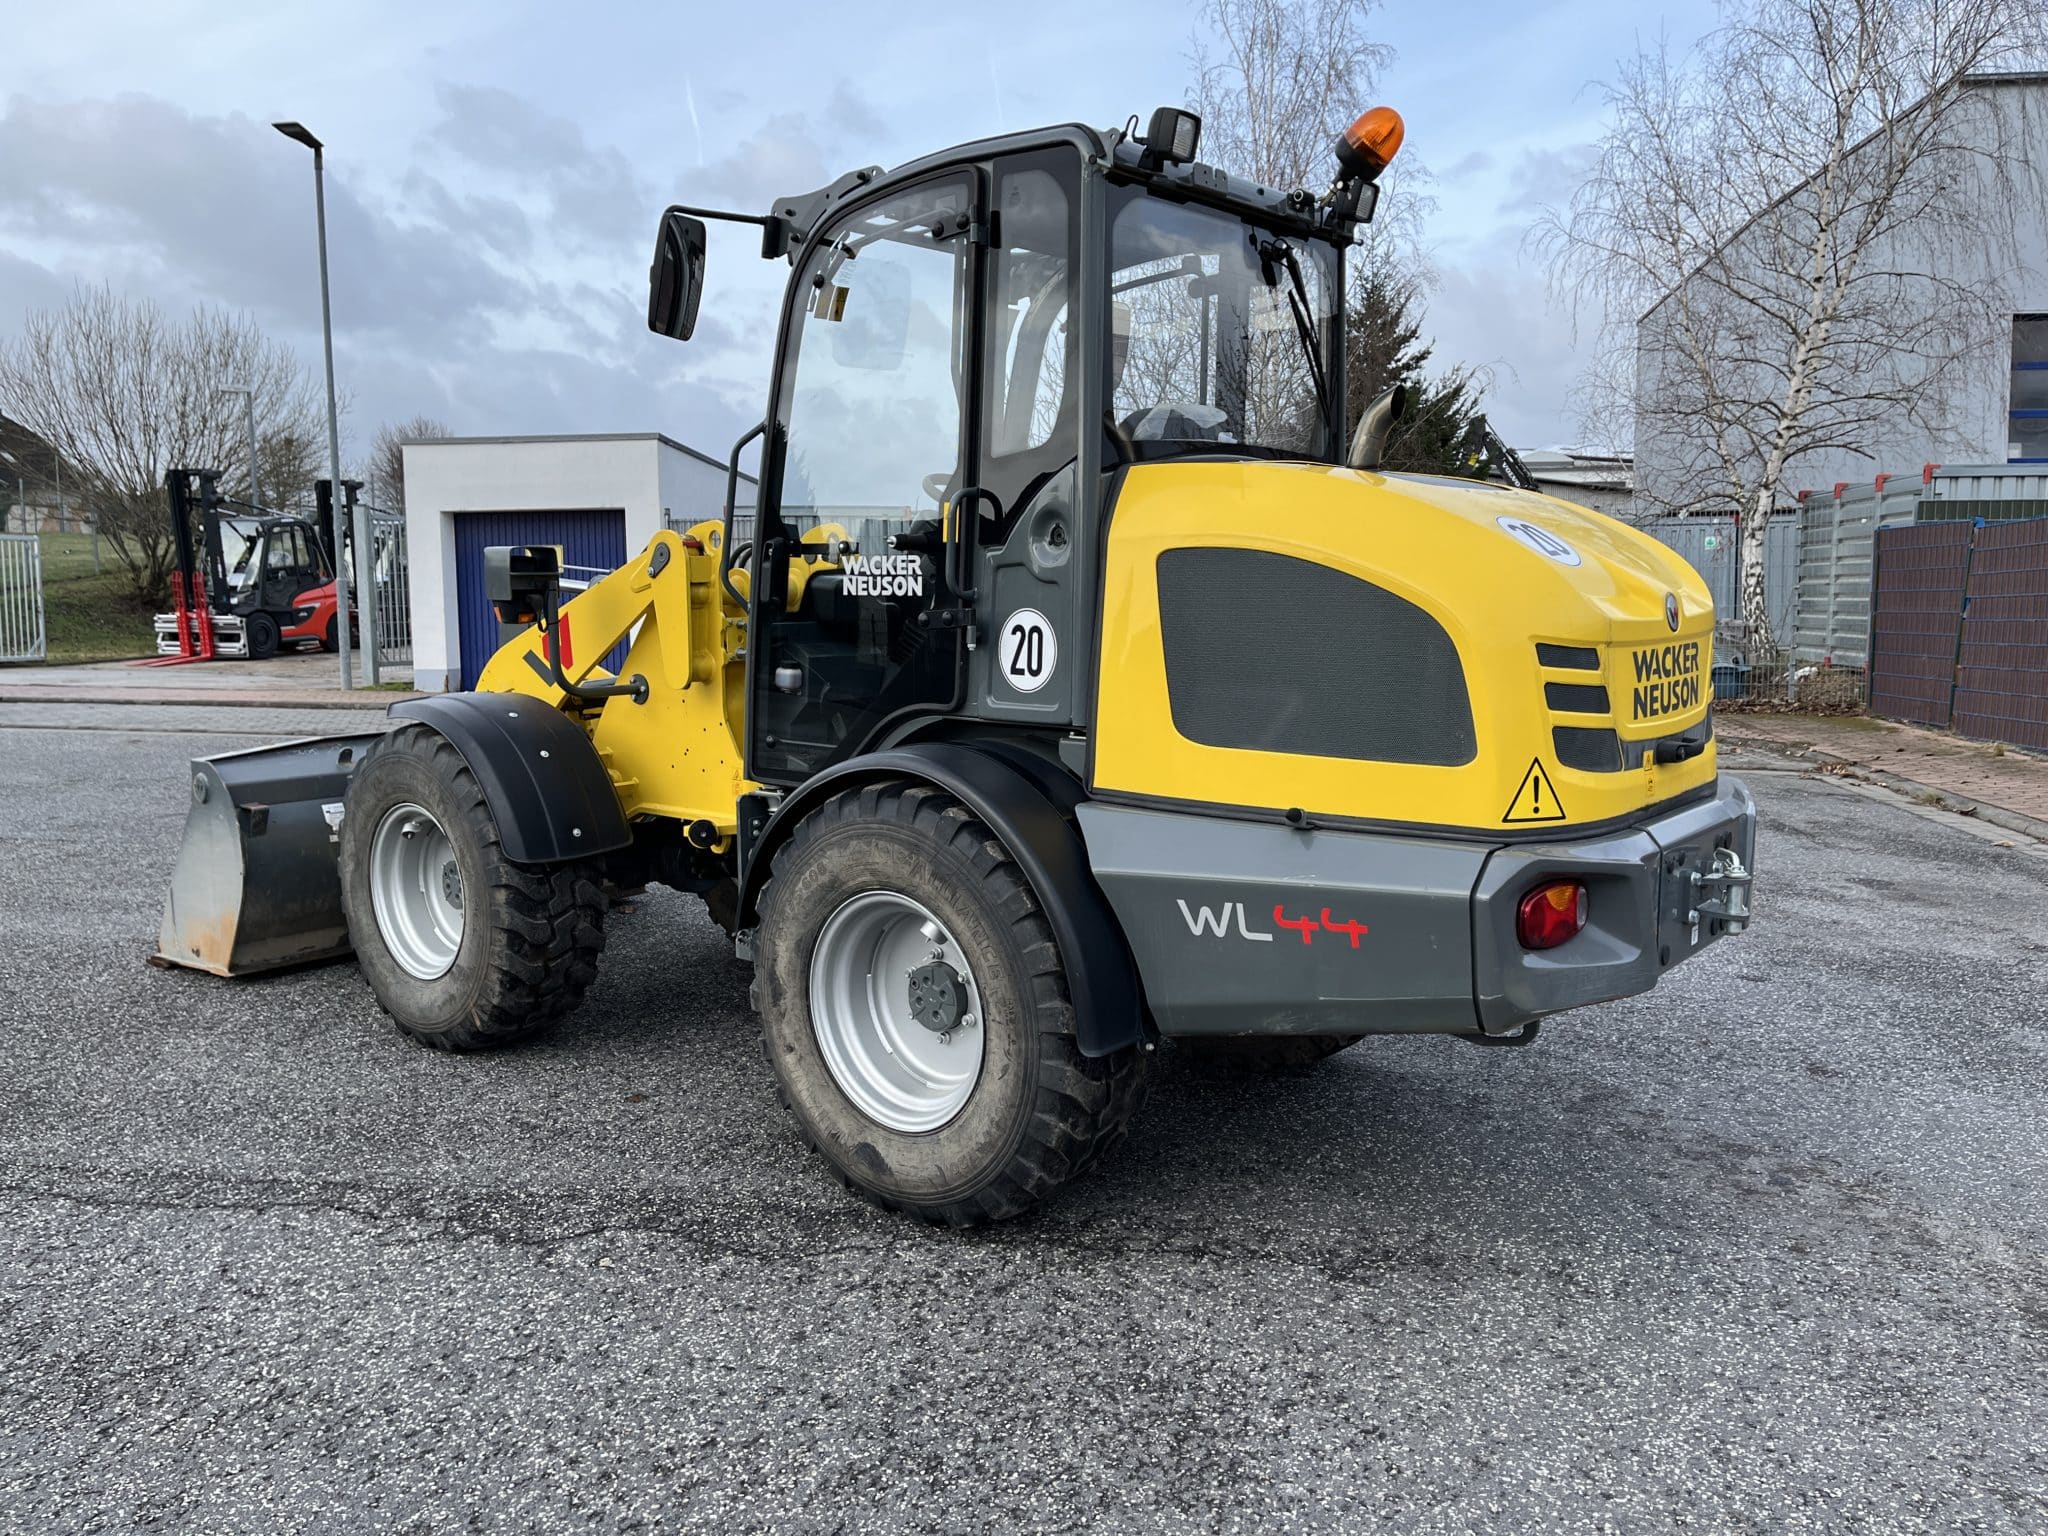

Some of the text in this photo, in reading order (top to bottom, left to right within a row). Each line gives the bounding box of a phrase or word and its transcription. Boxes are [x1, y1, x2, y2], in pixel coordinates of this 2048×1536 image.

[1502, 459, 1521, 487] VOLVO
[1507, 523, 1571, 556] 20
[841, 554, 923, 576] WACKER
[842, 575, 923, 597] NEUSON
[1010, 624, 1044, 677] 20
[1632, 641, 1699, 684] WACKER
[1633, 674, 1699, 721] NEUSON
